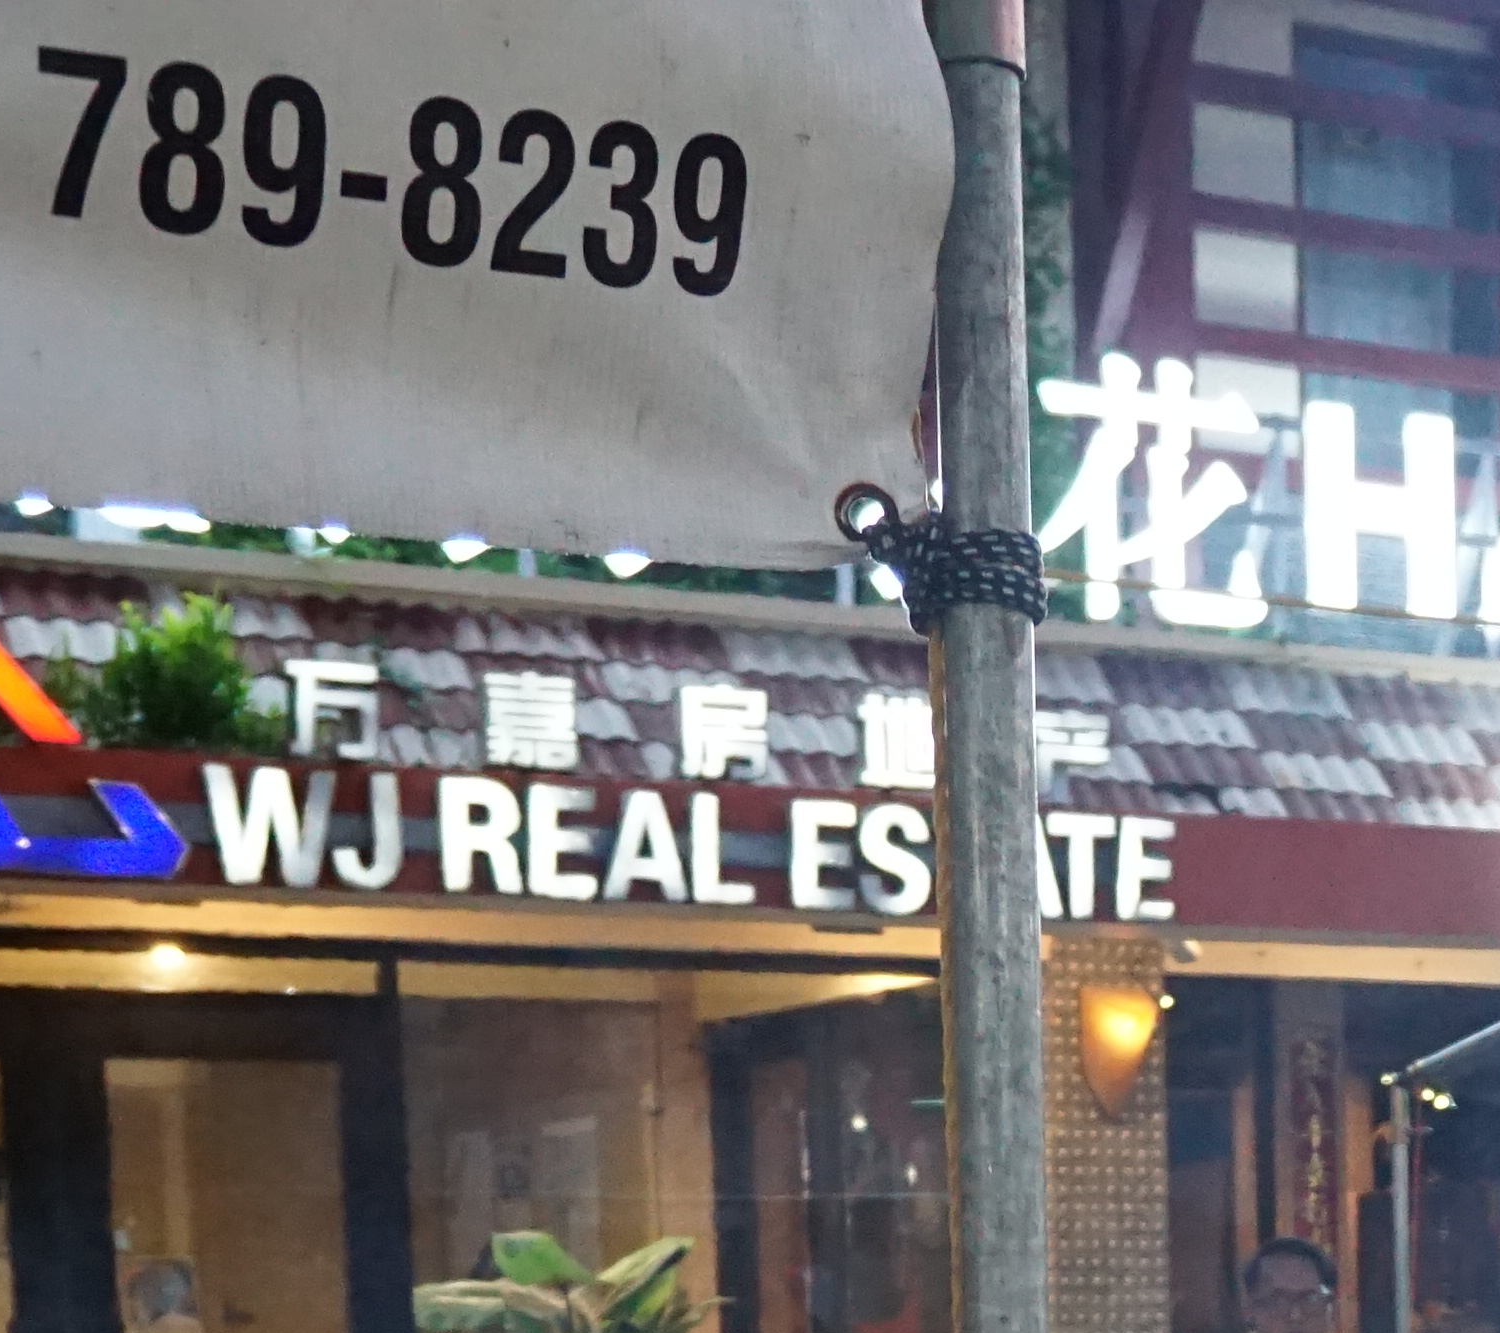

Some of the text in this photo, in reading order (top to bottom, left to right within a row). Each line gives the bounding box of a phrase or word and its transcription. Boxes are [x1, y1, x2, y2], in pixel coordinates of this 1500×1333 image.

[38, 45, 748, 297] 789-8239
[1037, 352, 1269, 628] 花
[205, 765, 1176, 921] WJ REAL ESTE
